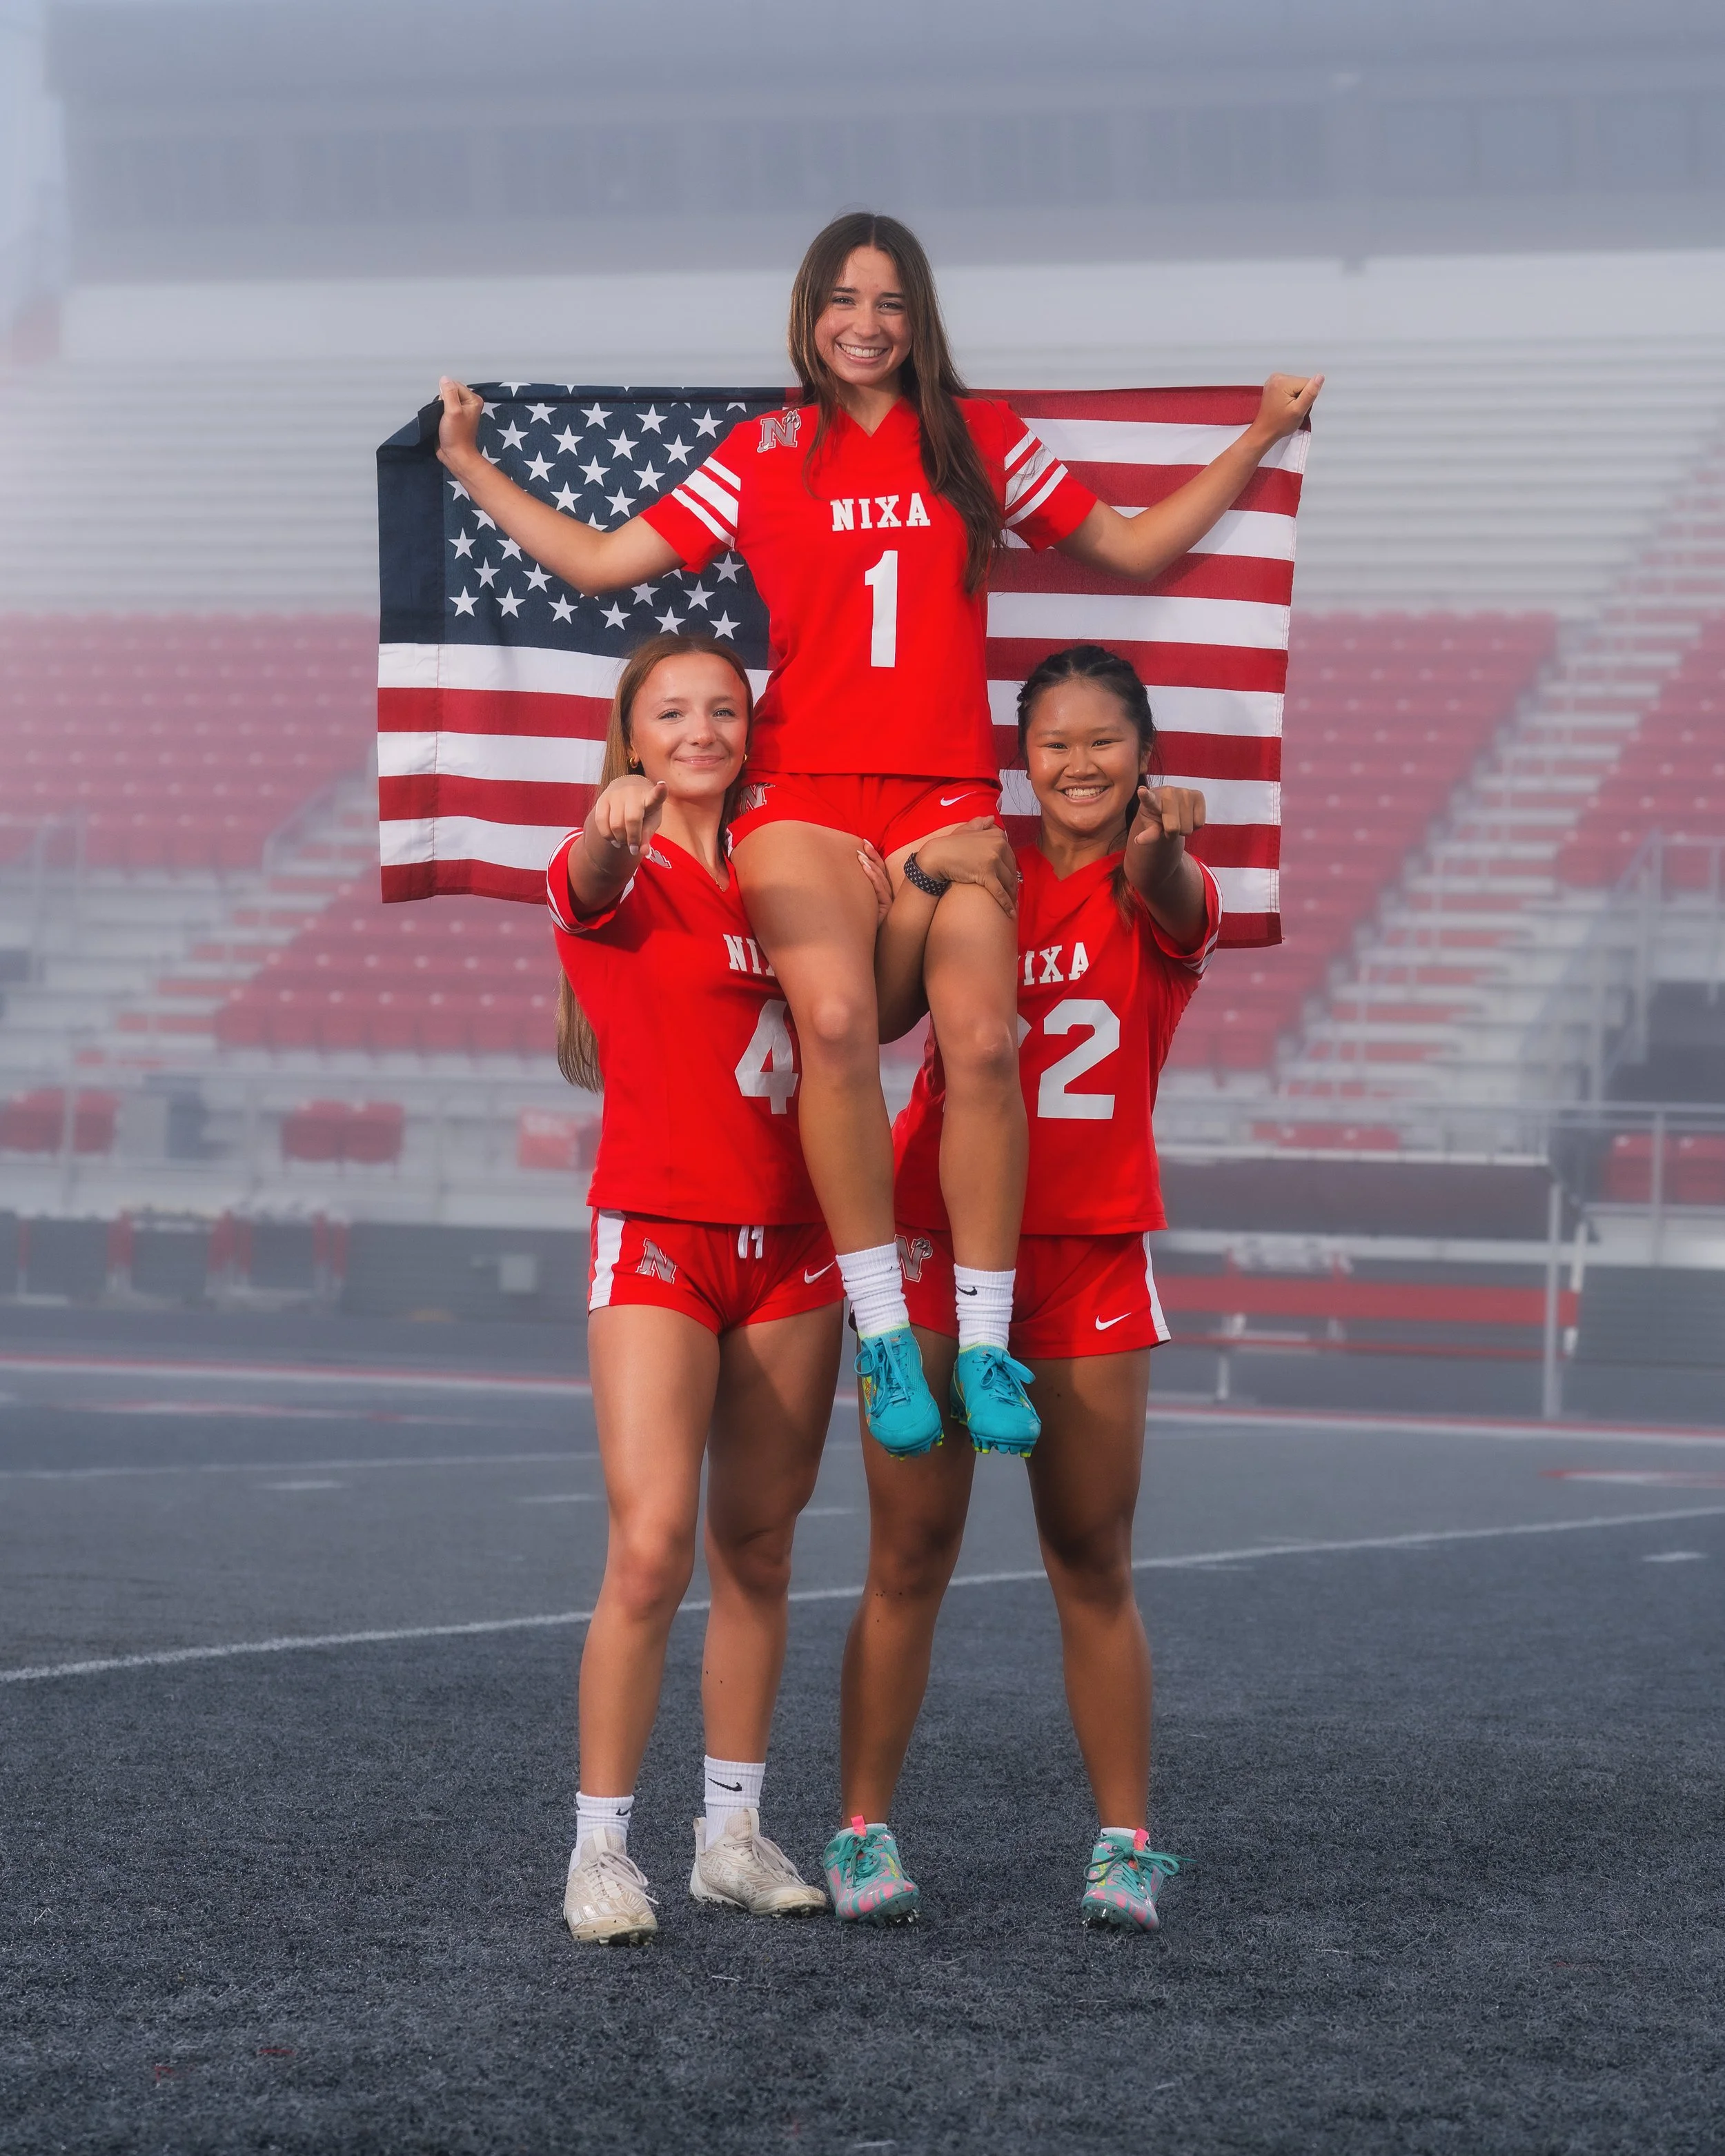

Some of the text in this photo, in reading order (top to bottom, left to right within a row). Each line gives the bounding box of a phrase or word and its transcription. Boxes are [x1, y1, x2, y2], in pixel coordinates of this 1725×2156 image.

[757, 410, 801, 453] N
[830, 492, 930, 531] NIXA
[865, 550, 898, 668] 1
[722, 933, 776, 977] NI
[1018, 942, 1089, 986] IXA
[734, 999, 798, 1115] 4
[1016, 999, 1121, 1120] 2
